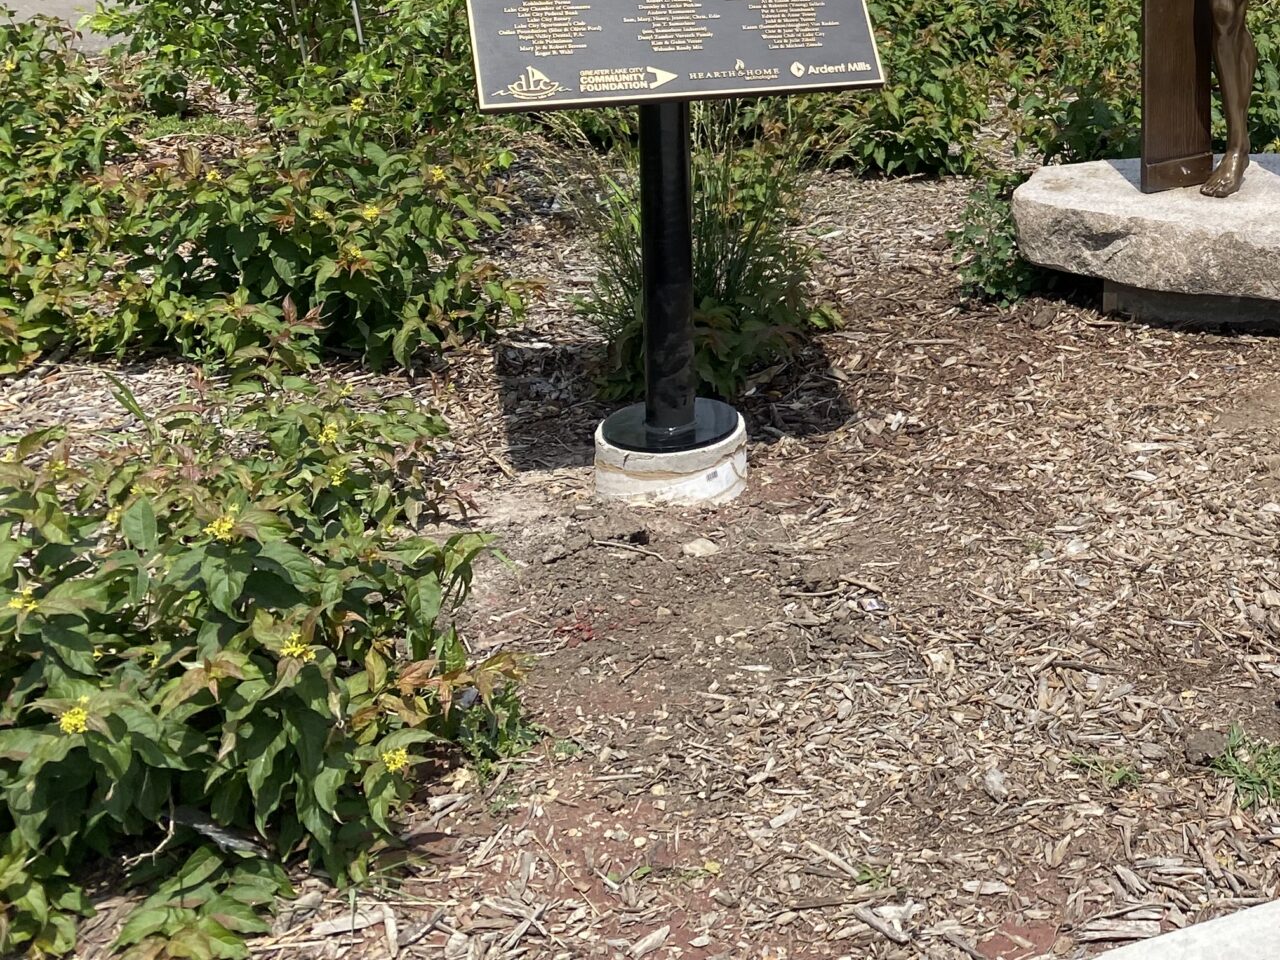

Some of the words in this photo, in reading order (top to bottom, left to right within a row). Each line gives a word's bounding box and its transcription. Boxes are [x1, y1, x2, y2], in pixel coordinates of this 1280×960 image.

[808, 63, 845, 74] Ardent
[848, 62, 871, 72] Mills
[580, 73, 645, 84] COMMUNITY
[689, 71, 736, 80] HEARTH
[746, 68, 780, 76] HOME
[580, 81, 648, 92] FOUNDATION
